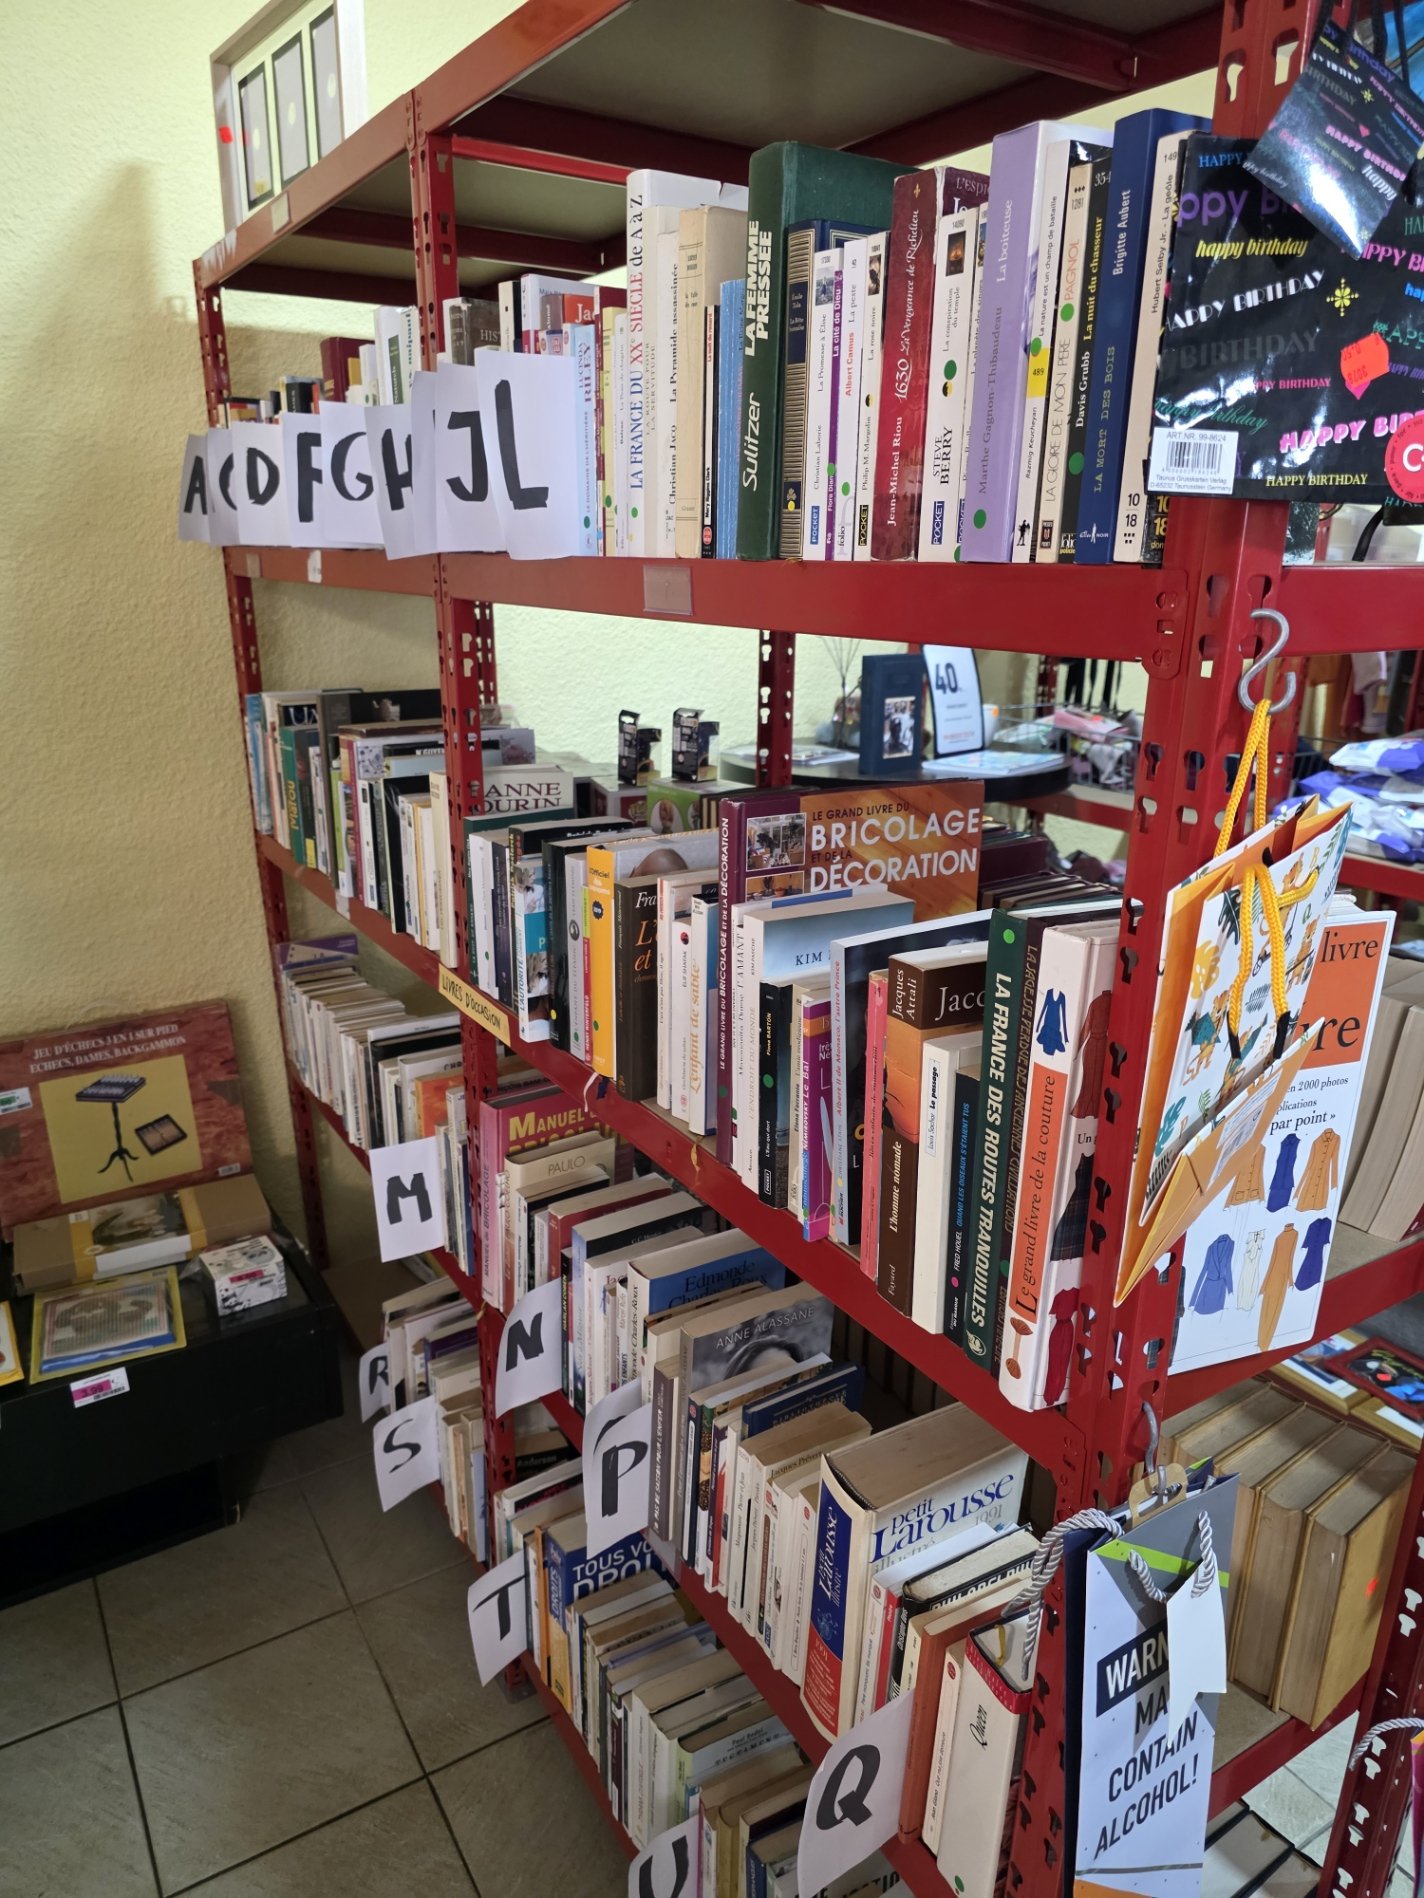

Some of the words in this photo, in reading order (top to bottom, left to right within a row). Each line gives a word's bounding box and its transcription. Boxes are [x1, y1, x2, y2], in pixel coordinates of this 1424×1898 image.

[1199, 153, 1245, 168] HAPPY
[630, 195, 643, 208] Z
[1362, 165, 1397, 200] happy
[630, 212, 643, 223] à
[1119, 189, 1131, 228] Aubert
[1164, 207, 1170, 221] La
[631, 228, 643, 240] A
[906, 209, 923, 264] Richelieu
[999, 200, 1013, 262] boiteuse
[1091, 217, 1104, 271] chasseur
[1195, 240, 1245, 258] happy
[1247, 238, 1308, 257] birthday
[629, 246, 643, 266] de
[746, 221, 759, 319] FEMME
[910, 264, 915, 276] de
[1065, 239, 1079, 301] PAGNOL
[1113, 230, 1127, 275] Brigitte
[1156, 246, 1165, 276] Selby
[756, 231, 772, 339] PRESSEE
[997, 265, 1005, 283] La
[1088, 273, 1097, 291] du
[1233, 270, 1325, 312] BIRTHDAY
[630, 272, 643, 332] SIECLE
[1087, 293, 1095, 321] nuit
[1152, 279, 1161, 314] Hubert
[834, 311, 840, 324] de
[849, 311, 855, 323] La
[1084, 324, 1093, 341] La
[669, 327, 679, 385] Pyramide
[745, 322, 755, 356] LA
[833, 346, 839, 357] La
[846, 332, 854, 364] Camus
[630, 371, 643, 396] DU
[845, 366, 853, 396] Albert
[895, 358, 912, 400] 1630
[1033, 368, 1044, 376] 489
[1079, 351, 1090, 392] Grubb
[1105, 346, 1115, 383] BOIS
[1279, 378, 1331, 390] BIRTHDAY
[670, 388, 677, 402] La
[1054, 373, 1067, 413] MON
[1101, 389, 1111, 420] DES
[630, 400, 643, 464] FRANCE
[1052, 420, 1062, 436] DE
[1075, 400, 1085, 428] Davis
[494, 379, 549, 510] L
[742, 392, 761, 492] Sulitzer
[1096, 429, 1107, 468] MORT
[1280, 419, 1367, 453] HAPPY
[330, 431, 374, 501] G
[446, 410, 489, 502] J
[887, 451, 899, 526] Jean-Michel
[893, 417, 903, 447] Riou
[933, 436, 943, 477] STEVE
[940, 427, 953, 485] BERRY
[979, 447, 989, 494] Marthe
[184, 456, 207, 515] A
[246, 447, 280, 506] D
[296, 431, 323, 523] F
[630, 470, 643, 489] LA
[1046, 486, 1055, 501] LA
[1094, 473, 1103, 493] LA
[1266, 475, 1306, 487] HAPPY
[1308, 474, 1368, 486] BIRTHDAY
[1128, 493, 1140, 507] 10
[859, 505, 869, 545] POCKET
[933, 502, 944, 544] POCKET
[1126, 514, 1137, 527] 18
[935, 662, 958, 694] 40
[811, 808, 981, 851] BRICOLAGE
[812, 810, 823, 821] LE
[826, 806, 864, 820] GRAND
[866, 803, 893, 816] LIVRE
[895, 802, 910, 813] DU
[810, 848, 977, 892] DÉCORATION
[811, 853, 822, 863] ET
[824, 851, 836, 861] DE
[839, 850, 853, 859] LA
[796, 952, 823, 967] KIM
[1320, 930, 1378, 963] livre
[892, 969, 904, 1018] Jacques
[906, 978, 917, 1020] Attali
[994, 972, 1012, 998] LA
[34, 1048, 52, 1059] JEU
[989, 1003, 1009, 1083] FRANCE
[1298, 1078, 1320, 1091] 2000
[1322, 1076, 1349, 1090] photos
[987, 1084, 1003, 1126] DES
[1039, 1075, 1056, 1144] couture
[1270, 1116, 1293, 1135] par
[1295, 1110, 1328, 1131] point
[548, 1155, 586, 1176] PAULO
[891, 1141, 902, 1184] nomade
[981, 1127, 1000, 1201] ROUTES
[1036, 1150, 1047, 1164] la
[1032, 1167, 1044, 1189] de
[386, 1172, 433, 1225] M
[481, 1167, 490, 1229] BRICOLAGE
[889, 1186, 900, 1233] L'homme
[1028, 1194, 1042, 1234] livre
[685, 1260, 755, 1293] Edmonde
[953, 1254, 961, 1271] FRED
[971, 1205, 994, 1328] TRANQUILLES
[1023, 1238, 1036, 1287] grand
[505, 1311, 545, 1372] N
[716, 1329, 750, 1349] ANNE
[754, 1307, 815, 1333] ALASSANE
[369, 1355, 389, 1396] R
[382, 1418, 422, 1474] S
[601, 1440, 649, 1518] P
[869, 1474, 1014, 1563] Larousse
[891, 1497, 935, 1529] petit
[573, 1549, 625, 1581] TOUS
[472, 1573, 527, 1642] T
[969, 1704, 988, 1749] Queen
[1107, 1710, 1198, 1802] CONTAIN
[816, 1744, 881, 1831] Q
[1093, 1753, 1199, 1861] ALCOHOL!
